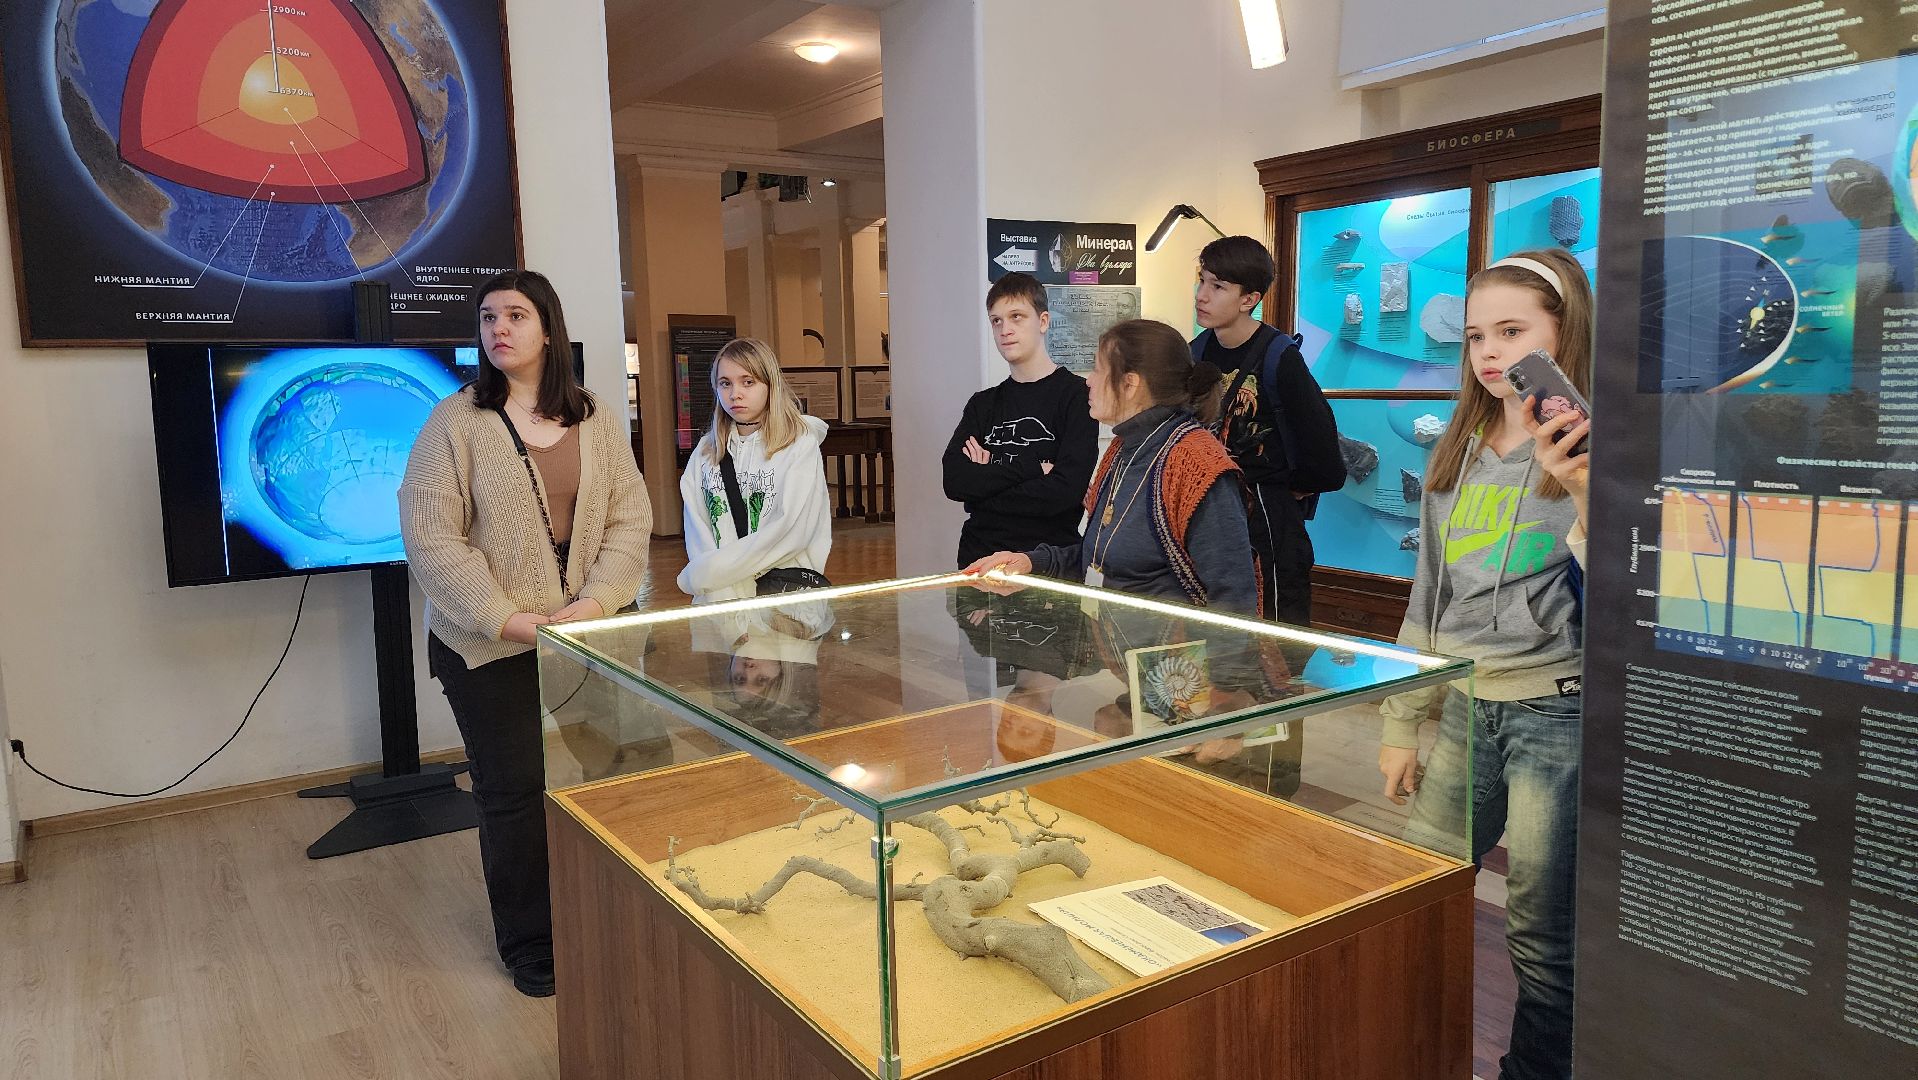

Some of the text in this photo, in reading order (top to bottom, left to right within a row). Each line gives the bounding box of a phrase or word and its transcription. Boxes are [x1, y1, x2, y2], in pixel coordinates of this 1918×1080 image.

[1427, 128, 1516, 152] БИОСФЕРА
[1000, 233, 1037, 244] Выставка
[1076, 234, 1133, 252] Минерал
[416, 266, 470, 274] ВНУТРЕННЕЕ
[94, 275, 191, 285] НИЖНЯЯ МАНТИЯ
[416, 276, 440, 284] ЯДРО
[136, 312, 231, 321] ВЕРХНЯЯ МАНТИЯ
[1838, 459, 1885, 469] свойства
[1450, 484, 1530, 530] NIKE
[1481, 531, 1556, 574] AIR
